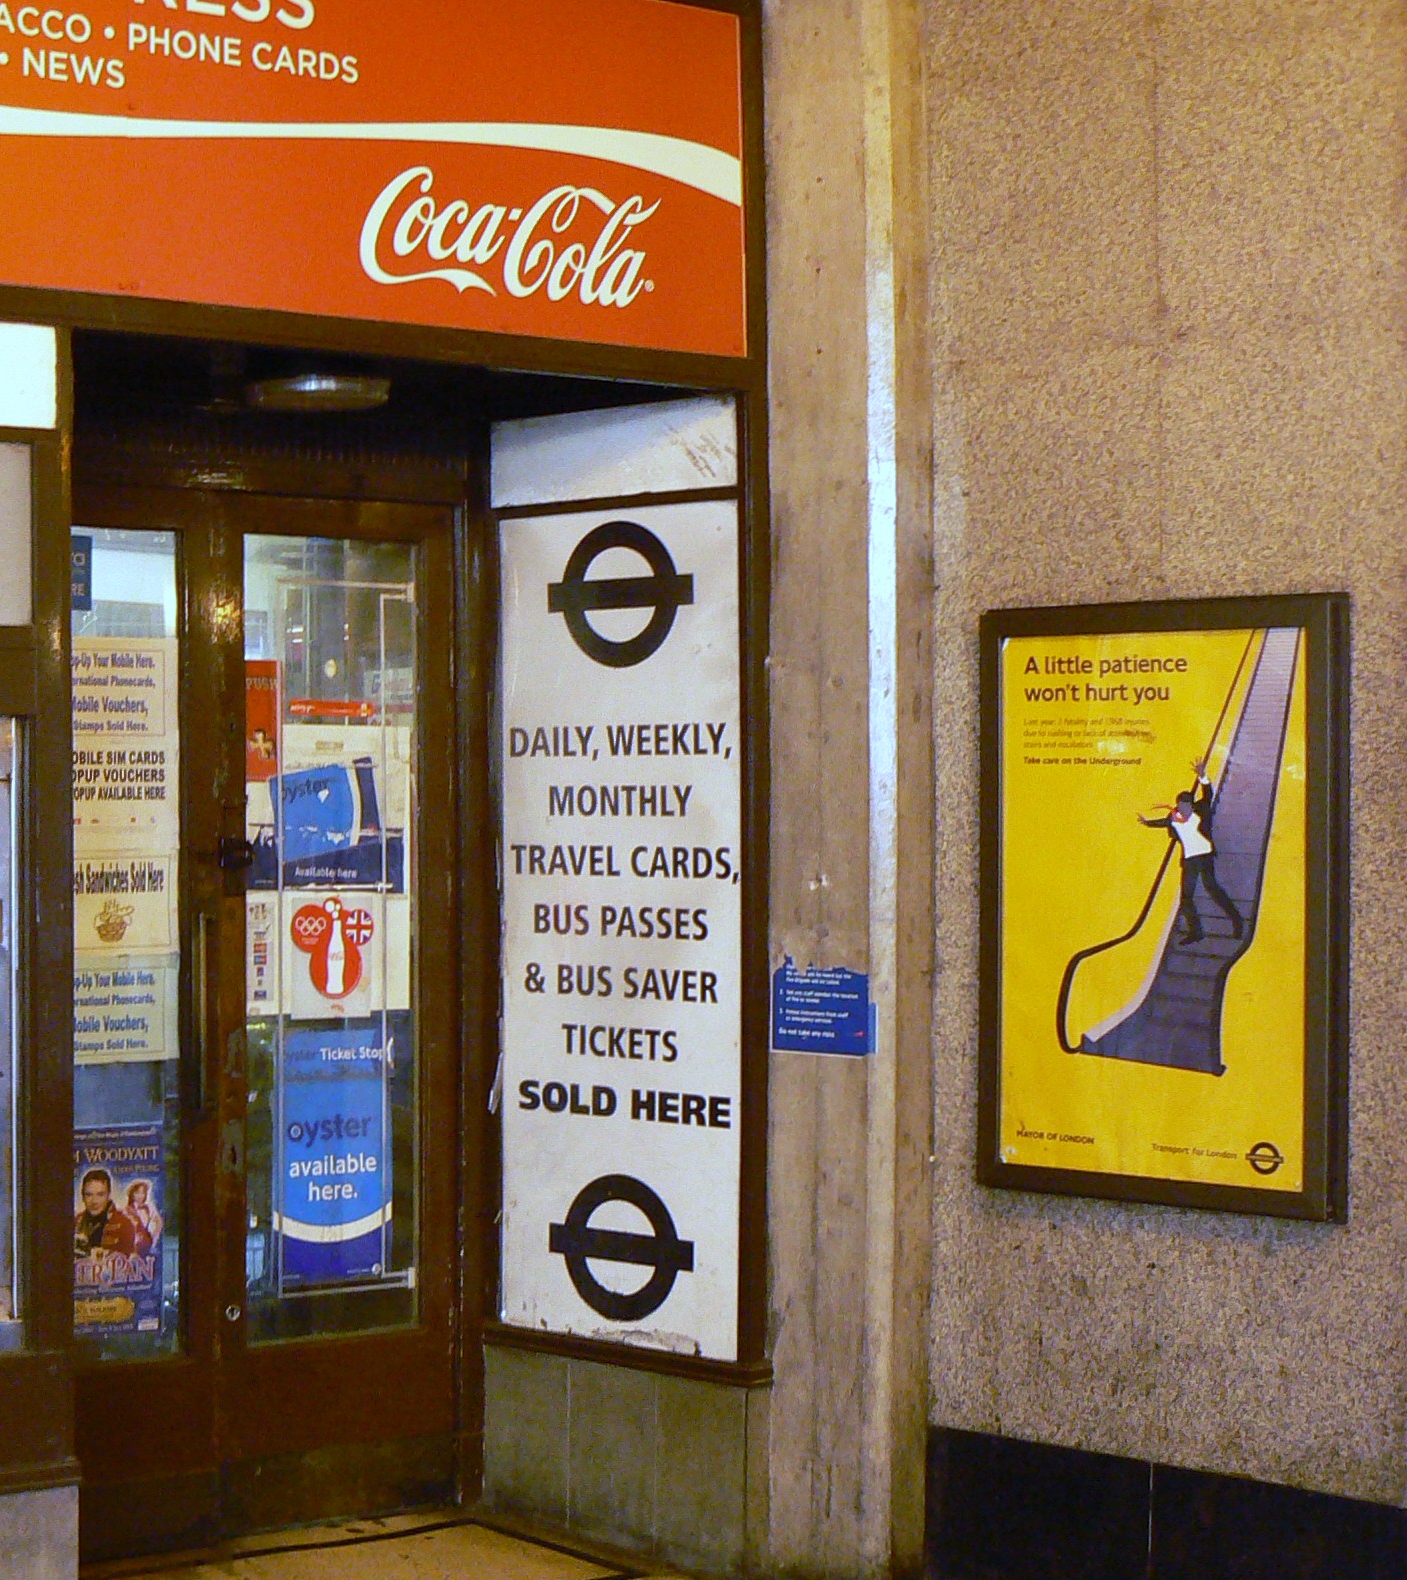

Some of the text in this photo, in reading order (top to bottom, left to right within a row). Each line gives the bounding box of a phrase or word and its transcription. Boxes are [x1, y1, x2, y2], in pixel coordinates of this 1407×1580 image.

[128, 22, 242, 67] PHONE
[251, 41, 359, 84] CARDS
[22, 47, 125, 89] NEWS
[359, 165, 661, 308] Coca-Cola
[1024, 654, 1187, 678] A little patience
[1024, 683, 1170, 706] won't hurt you
[509, 722, 732, 761] DAILY, WEEKLY,
[106, 751, 126, 765] SIM
[129, 751, 166, 765] CARDS
[1023, 756, 1142, 766] Take care on the Underground
[103, 768, 166, 783] VOUCHERS
[97, 786, 142, 801] AVAILABLE
[144, 786, 167, 800] HERE
[549, 785, 693, 817] MONTHLY
[130, 860, 146, 893] Sold
[294, 866, 358, 880] Available here
[511, 844, 740, 885] TRAVEL CARDS,
[533, 904, 708, 941] BUS PASSES
[524, 962, 718, 1004] & BUS SAVER
[320, 1047, 357, 1061] Ticket
[359, 1046, 383, 1061] Stop
[561, 1023, 678, 1062] TICKETS
[519, 1079, 731, 1130] SOLD HERE
[287, 1113, 373, 1147] oyster
[1016, 1129, 1095, 1144] MAYOR OF LONDON
[83, 1145, 159, 1163] WOODYATT
[1151, 1142, 1190, 1156] Transport
[1206, 1148, 1238, 1160] London
[289, 1152, 377, 1178] available
[308, 1182, 358, 1202] here.
